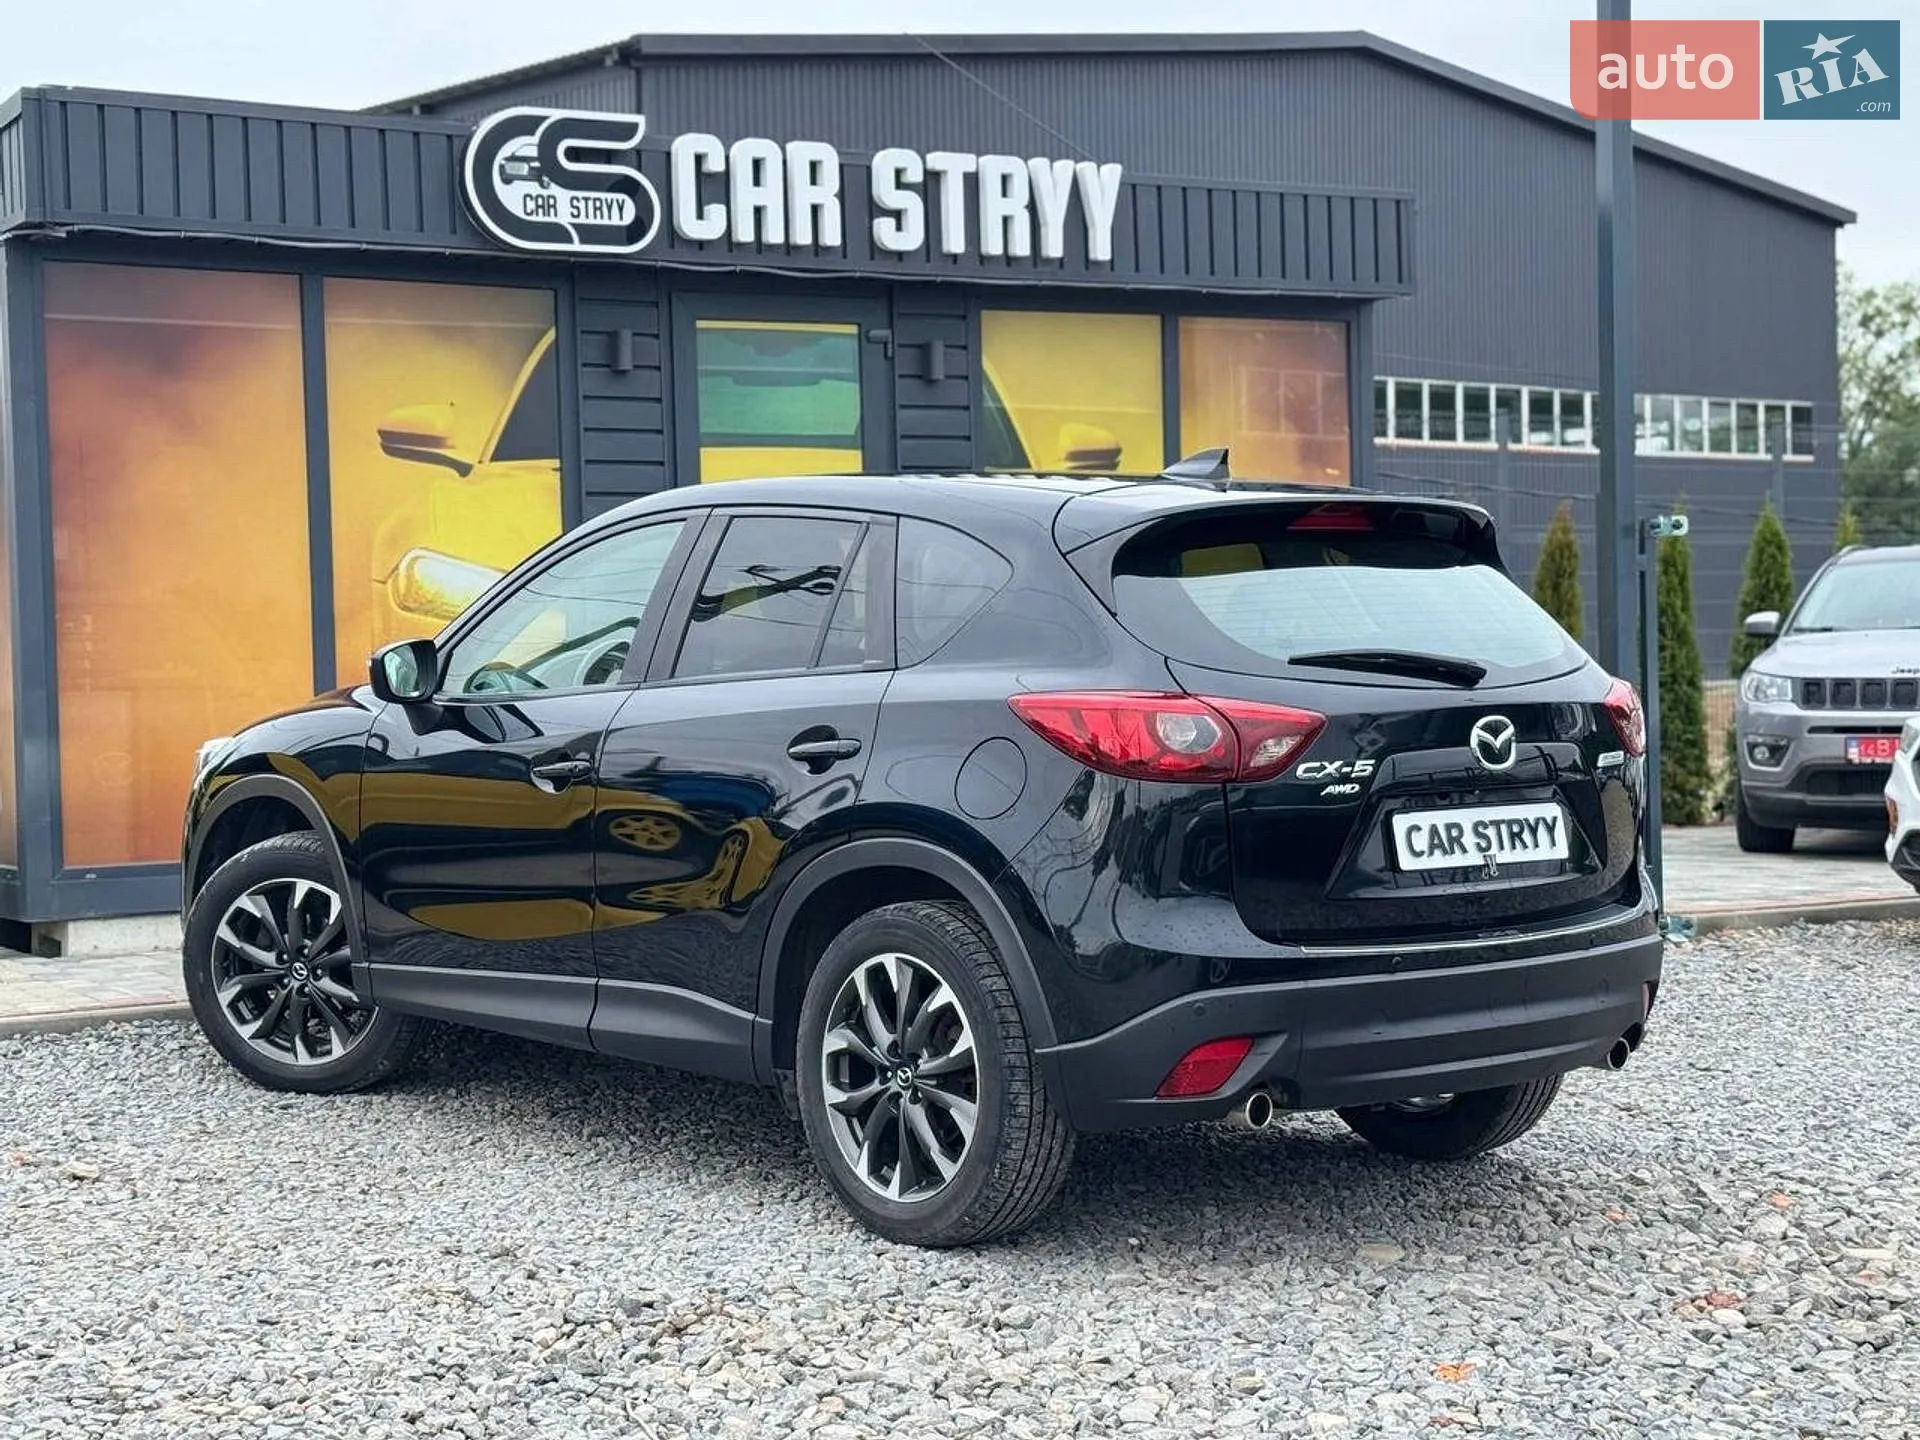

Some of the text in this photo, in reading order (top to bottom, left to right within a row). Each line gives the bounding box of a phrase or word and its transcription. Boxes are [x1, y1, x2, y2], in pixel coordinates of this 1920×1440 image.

[523, 193, 626, 222] CAR STRYY
[671, 132, 1123, 262] CAR STRYY
[1295, 759, 1376, 780] CX-5
[1320, 783, 1361, 797] AWD
[1404, 815, 1558, 859] CAR STRYY
